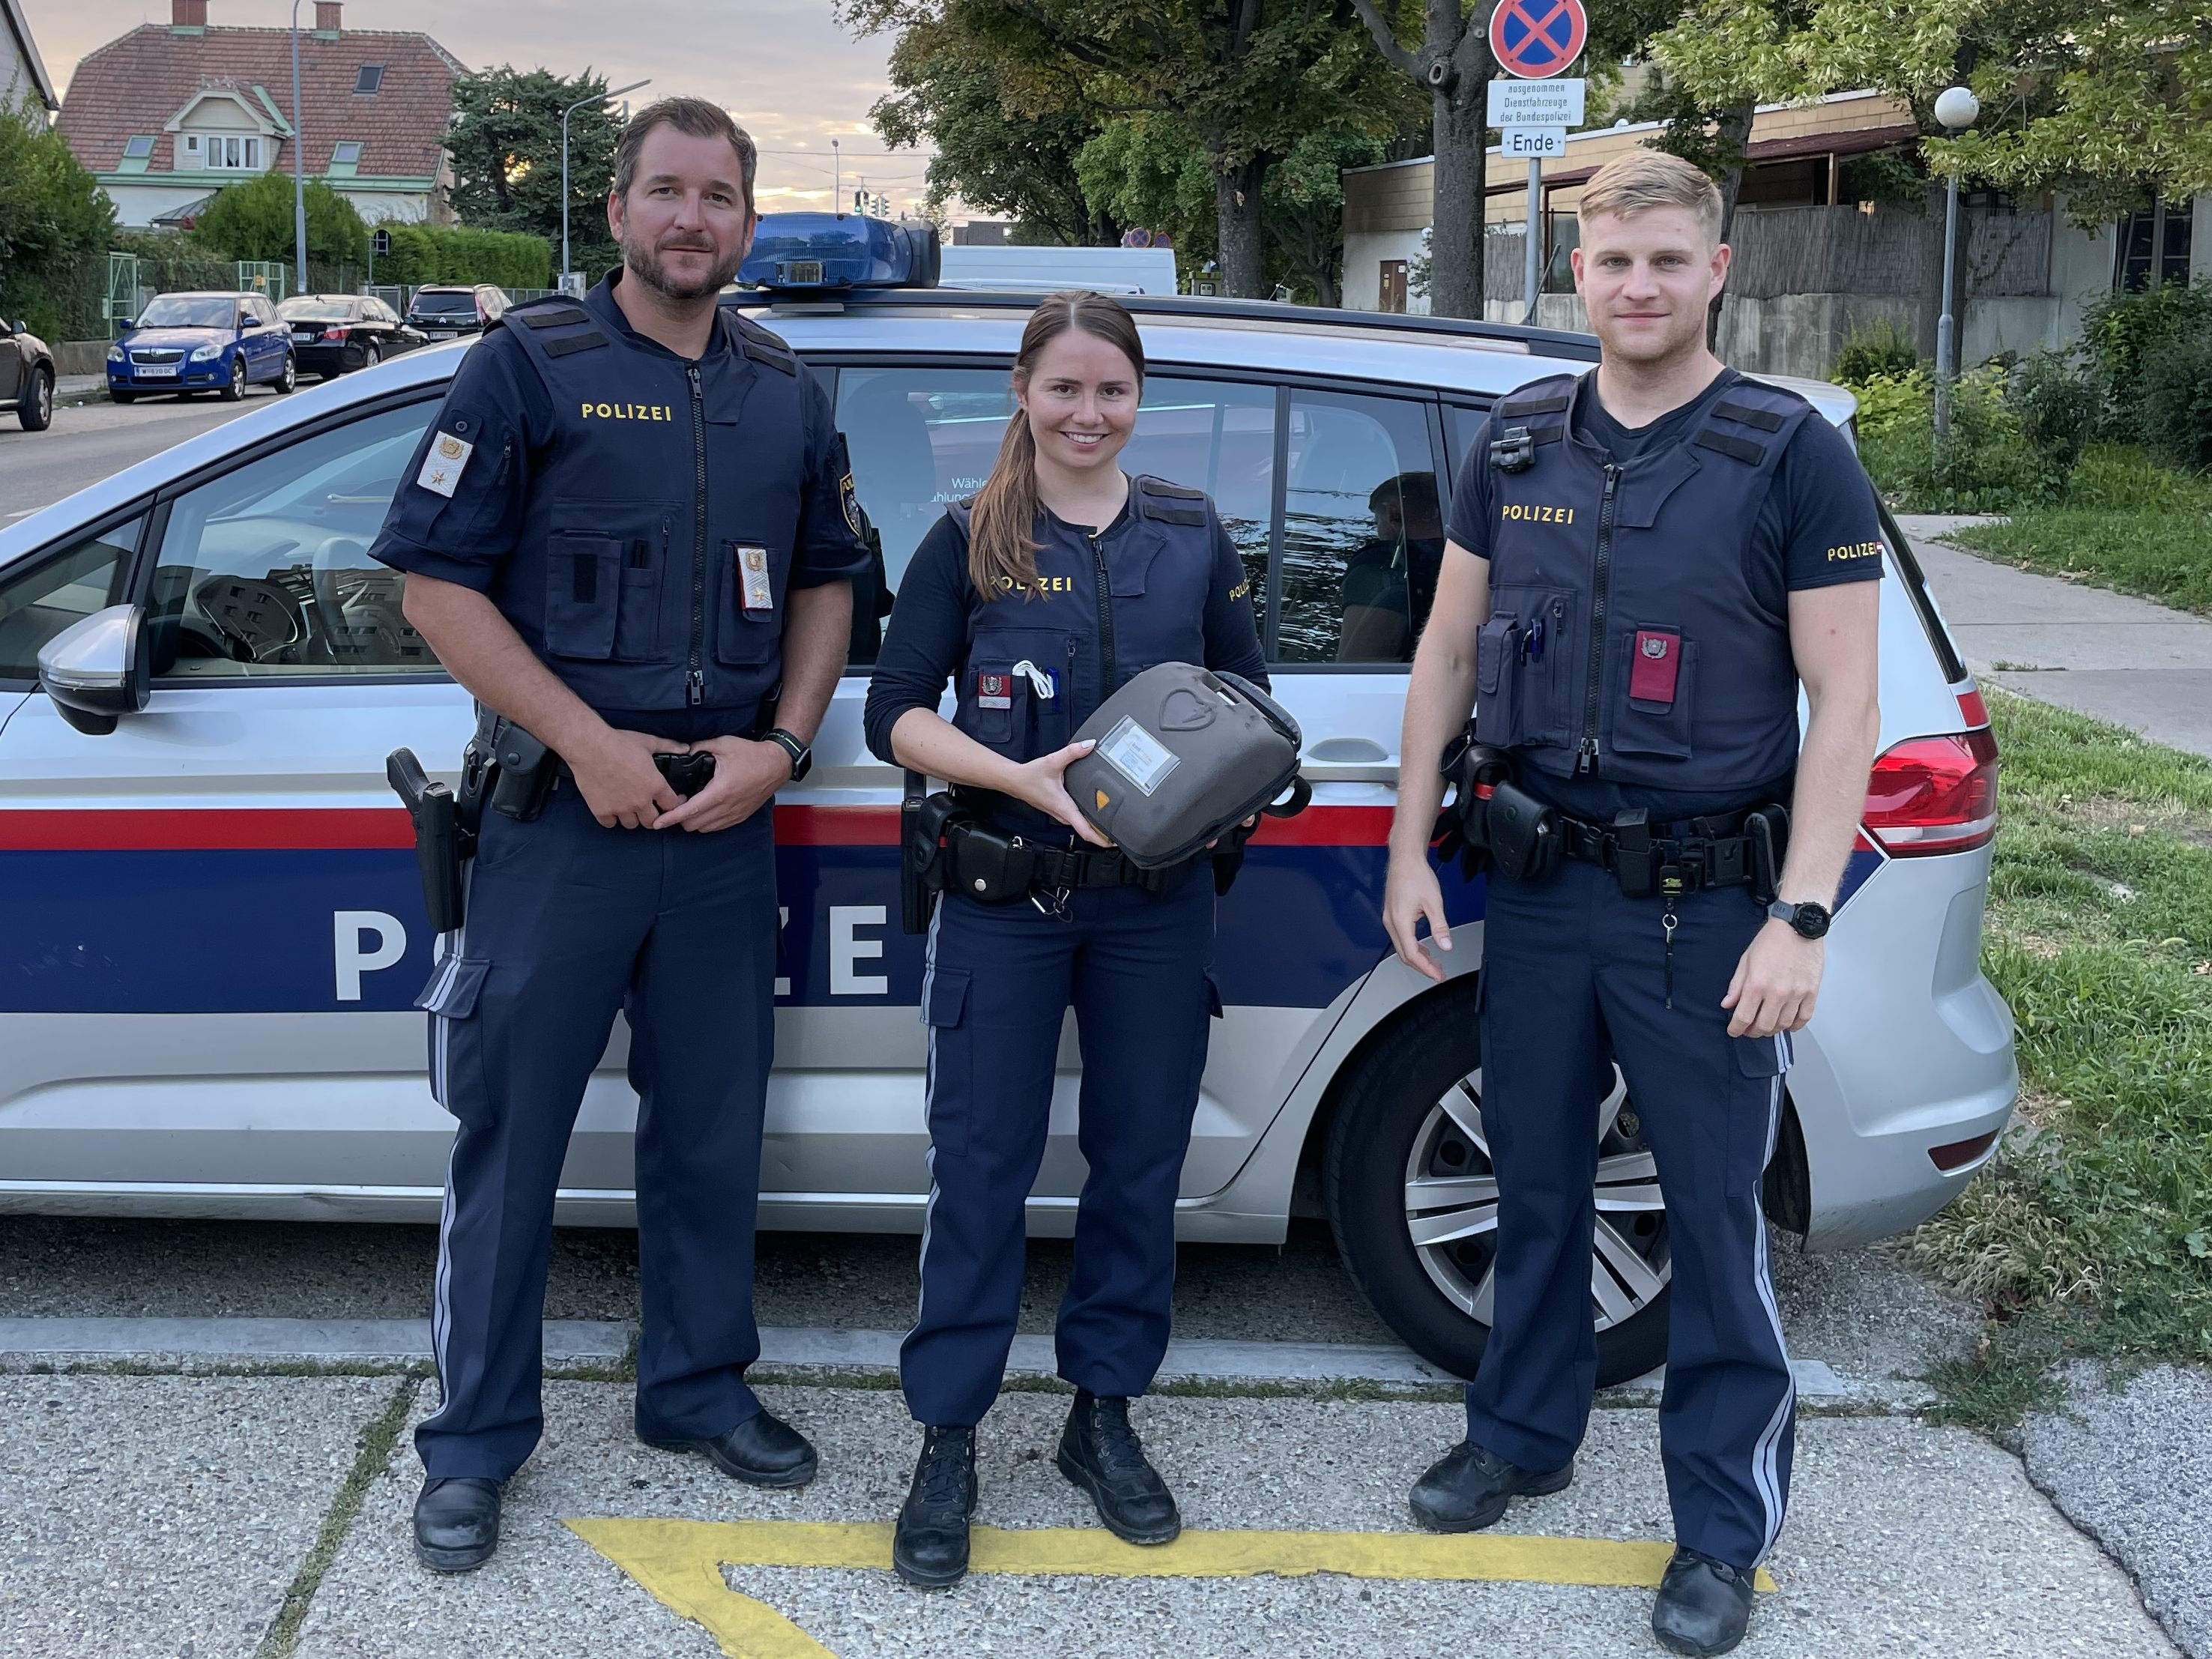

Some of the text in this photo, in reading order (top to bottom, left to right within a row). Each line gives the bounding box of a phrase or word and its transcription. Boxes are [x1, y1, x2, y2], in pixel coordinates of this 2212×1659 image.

[1508, 84, 1565, 94] ausgenommen
[1504, 97, 1568, 109] Dienstfahrzeuge
[1500, 110, 1571, 123] der Bundespolizei
[1514, 133, 1554, 151] Ende
[581, 403, 671, 421] POLIZEI
[1502, 504, 1574, 525] POLIZEI
[1828, 542, 1878, 561] POLIZEI
[990, 576, 1072, 591] OLZEI
